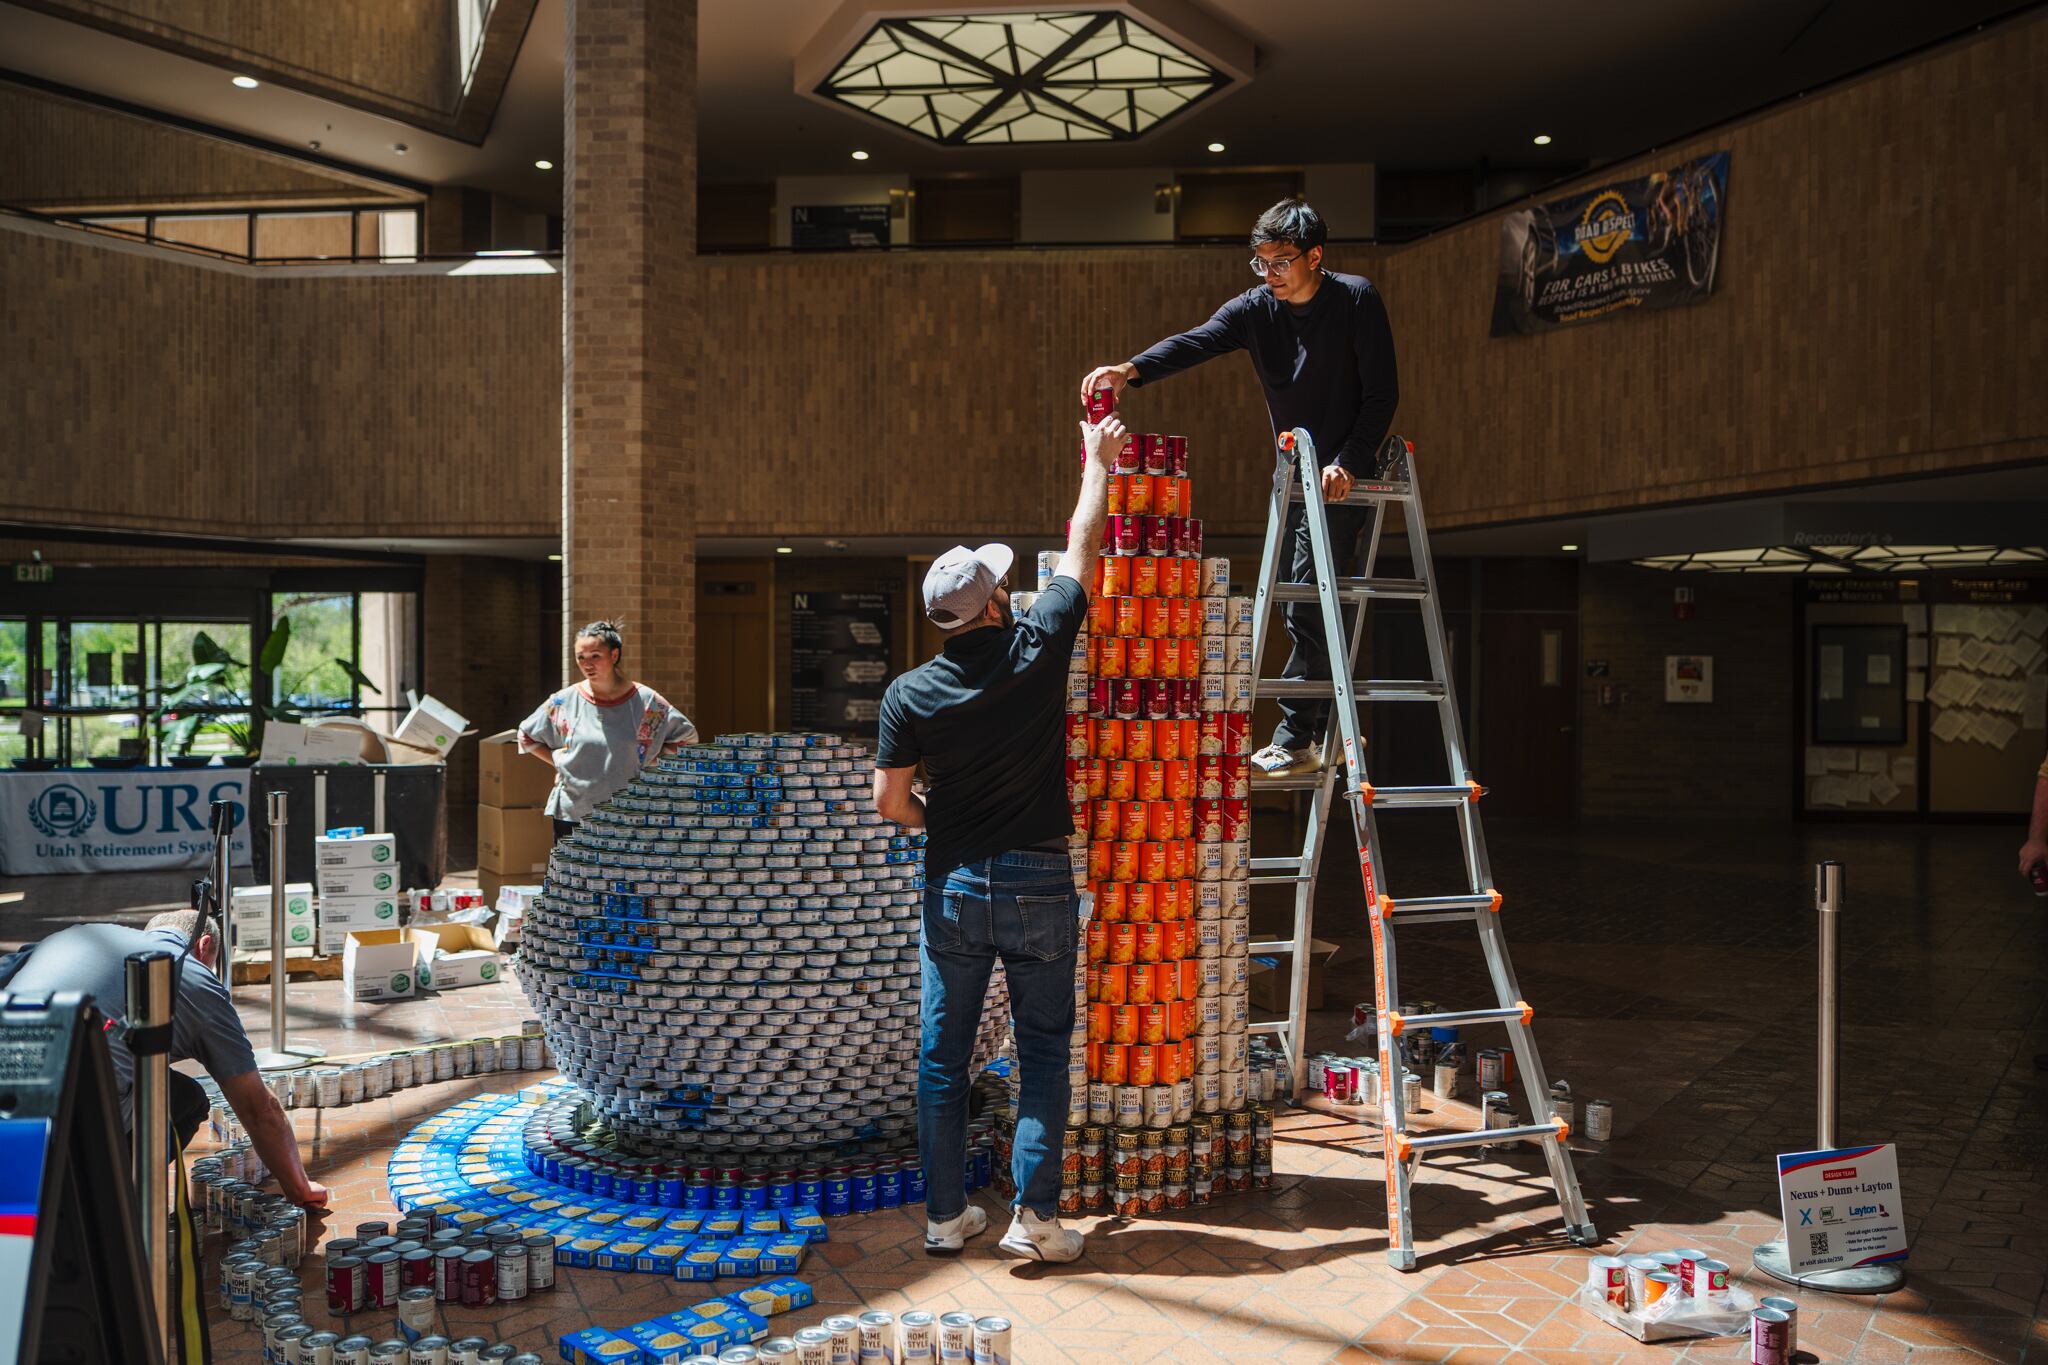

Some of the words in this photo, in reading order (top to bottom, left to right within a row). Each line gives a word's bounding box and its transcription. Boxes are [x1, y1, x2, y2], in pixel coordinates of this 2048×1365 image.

[794, 208, 808, 222] N
[1574, 222, 1600, 240] ROAD
[1542, 277, 1571, 295] FOR
[1575, 270, 1608, 289] CARS
[1621, 258, 1670, 275] BIKES
[1538, 290, 1577, 306] RESPECT
[1578, 288, 1588, 298] IS
[1638, 270, 1677, 284] STREET
[1794, 531, 1878, 546] Recorder's
[16, 564, 49, 583] EXIT
[794, 594, 808, 609] N
[35, 844, 75, 857] Utah
[81, 843, 173, 857] Retirement
[1091, 1089, 1108, 1097] HOME
[1167, 1130, 1188, 1138] STAGG
[1115, 1136, 1137, 1145] STAGG
[1115, 1177, 1138, 1185] STAGG
[1790, 1189, 1818, 1200] Nexus
[1828, 1185, 1852, 1197] Dunn
[1862, 1181, 1892, 1194] Layton
[1849, 1205, 1877, 1216] Layton
[1806, 1258, 1816, 1266] visit
[861, 1332, 880, 1340] HOME
[908, 1332, 928, 1340] HOME
[832, 1337, 848, 1345] OME
[861, 1340, 880, 1348] STYLE
[908, 1340, 928, 1348] STYLE
[832, 1345, 848, 1353] TYLE
[804, 1350, 824, 1359] HOME
